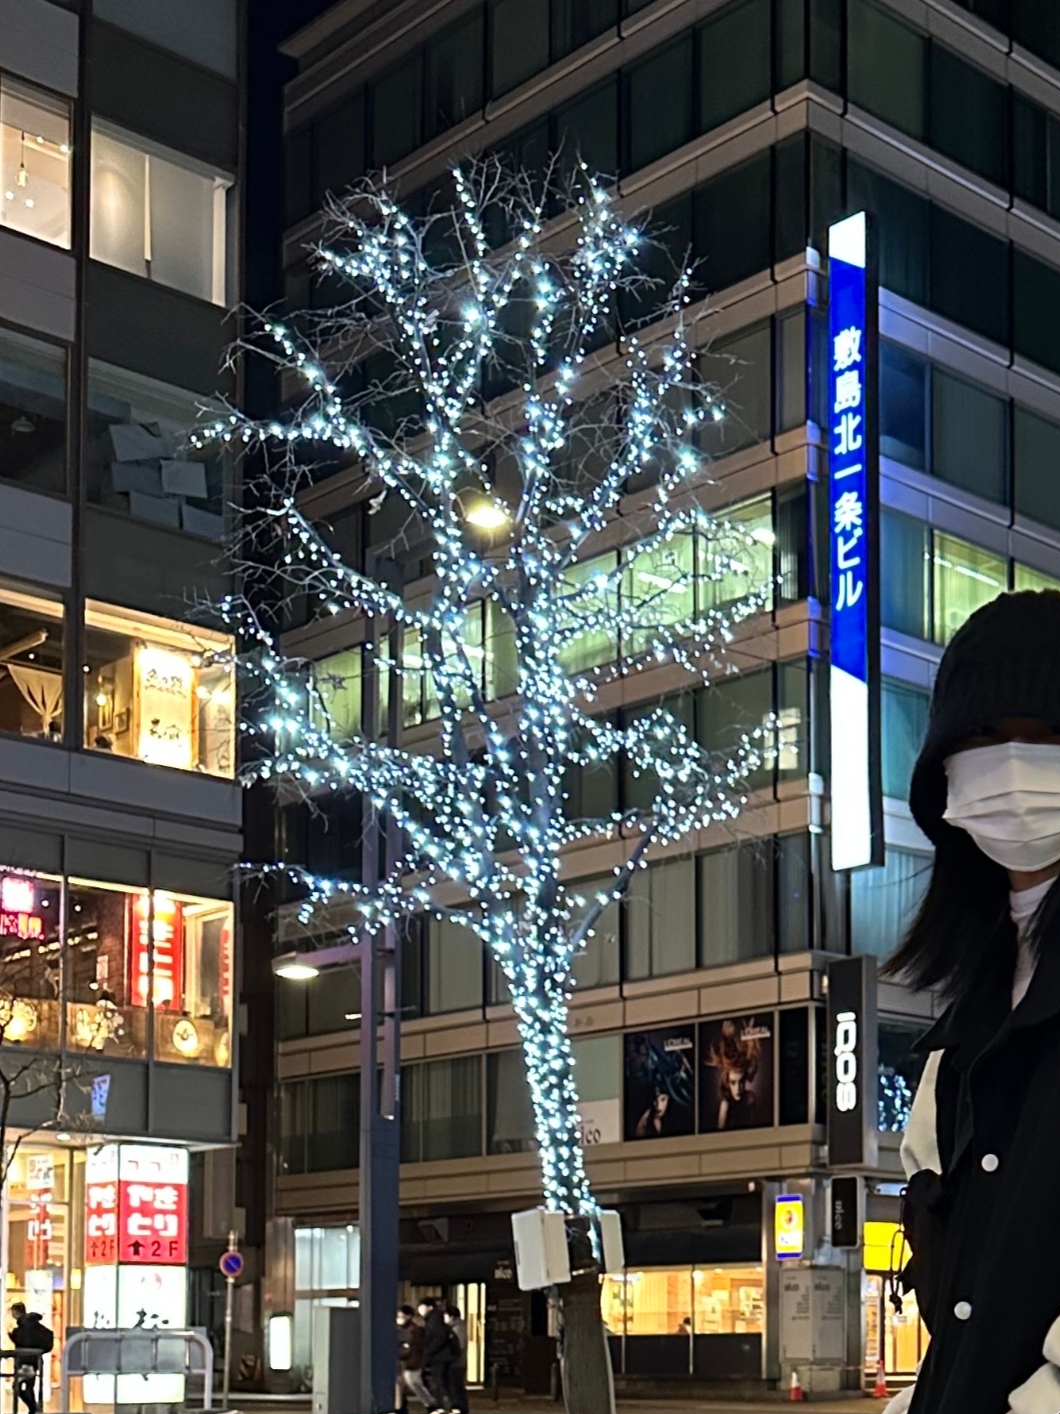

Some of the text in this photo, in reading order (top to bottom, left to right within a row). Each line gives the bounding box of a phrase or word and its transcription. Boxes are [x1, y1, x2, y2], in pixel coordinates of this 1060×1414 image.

[833, 325, 864, 611] 敷島北一条ビル
[834, 1011, 857, 1112] IQOS
[127, 1184, 179, 1210] やき
[127, 1213, 179, 1237] とり
[151, 1240, 179, 1257] 2F
